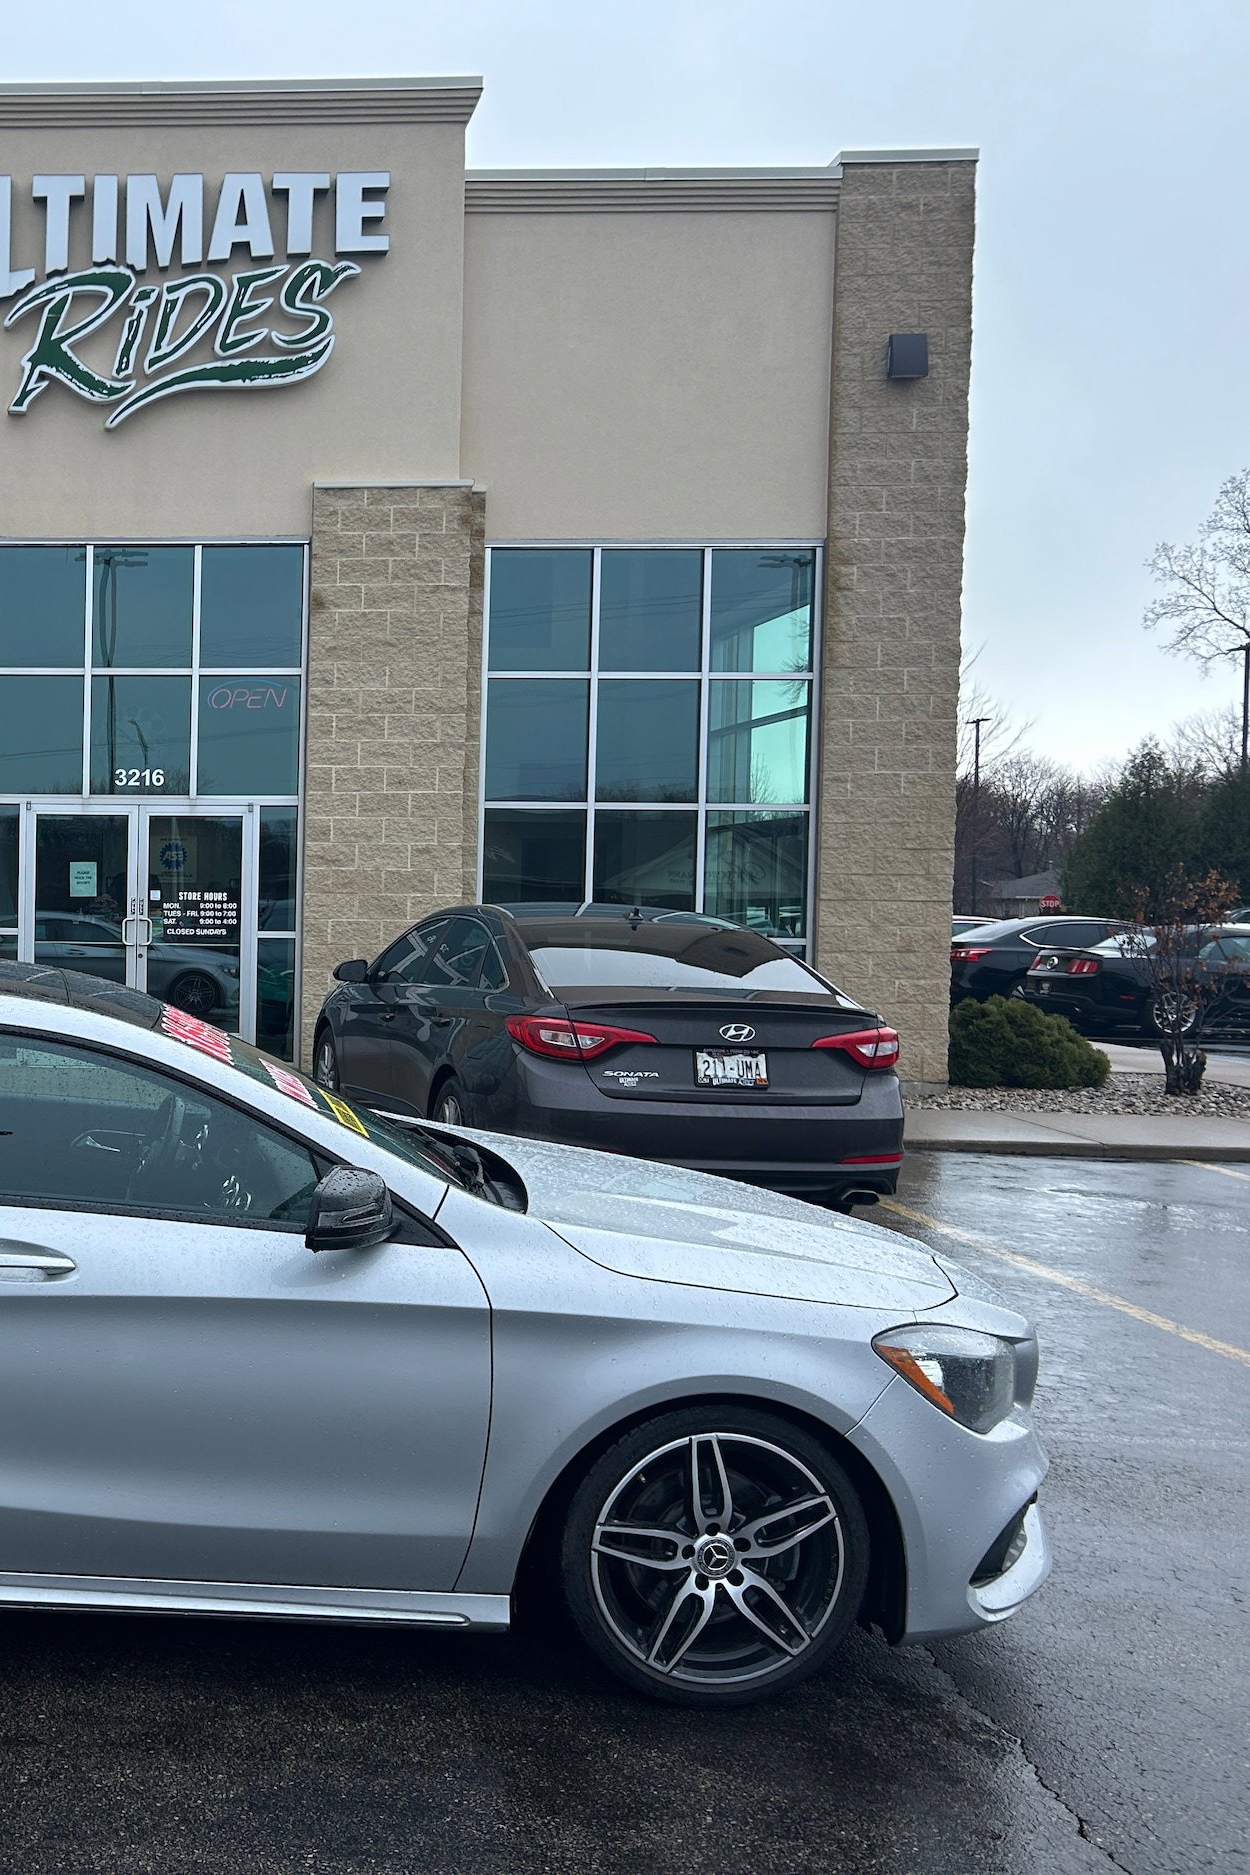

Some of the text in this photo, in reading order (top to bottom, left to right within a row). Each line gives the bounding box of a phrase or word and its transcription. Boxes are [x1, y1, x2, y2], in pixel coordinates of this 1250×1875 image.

[211, 688, 287, 709] OPEN
[114, 768, 165, 786] 3216
[178, 892, 228, 901] STORE HOURS
[1041, 900, 1061, 908] STOP
[195, 928, 227, 936] SUNDAYS
[602, 1070, 660, 1078] SONATA
